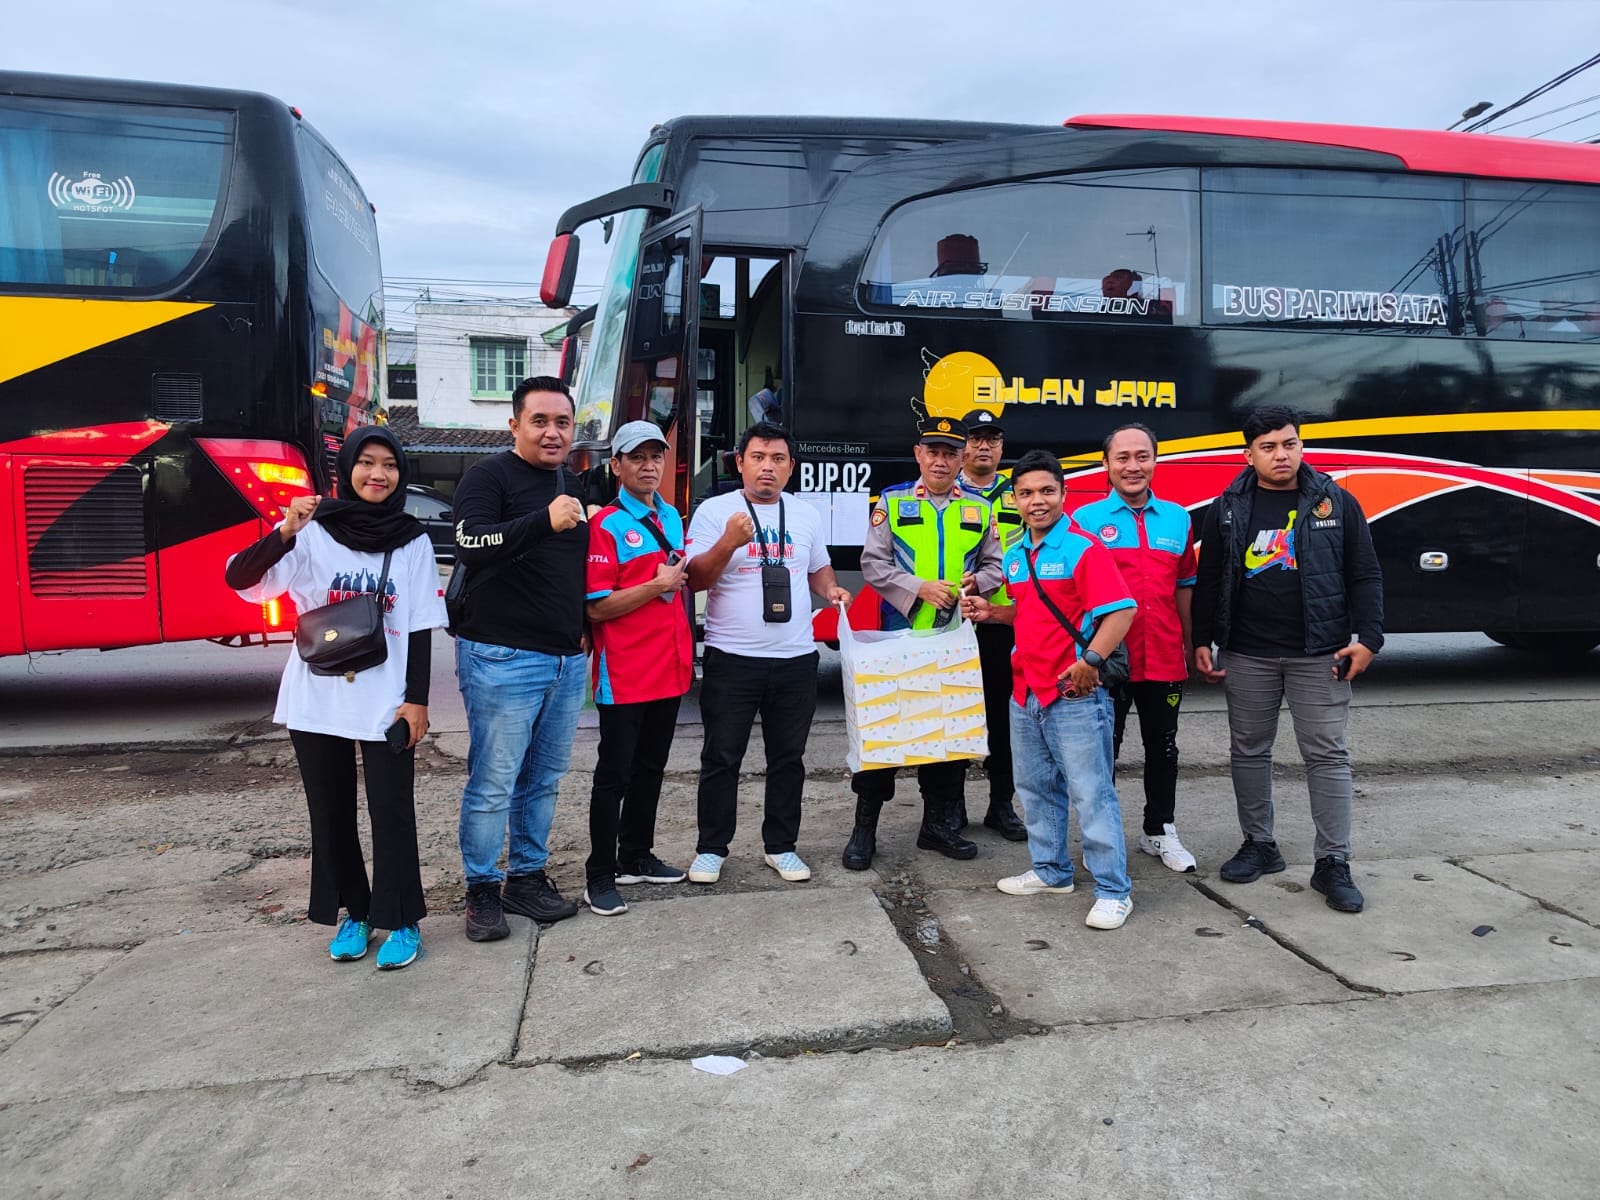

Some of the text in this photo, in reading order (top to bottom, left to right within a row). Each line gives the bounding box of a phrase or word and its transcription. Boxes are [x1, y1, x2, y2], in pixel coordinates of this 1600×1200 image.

[83, 171, 101, 179] Free
[73, 204, 113, 213] HOTSPOT
[901, 290, 1150, 316] AIR SUSPENSION
[1223, 286, 1447, 325] BUS PARIWISATA
[973, 376, 1176, 408] BULAN JAYA
[798, 443, 866, 454] Mercedes-Benz
[800, 462, 872, 492] BJP.02
